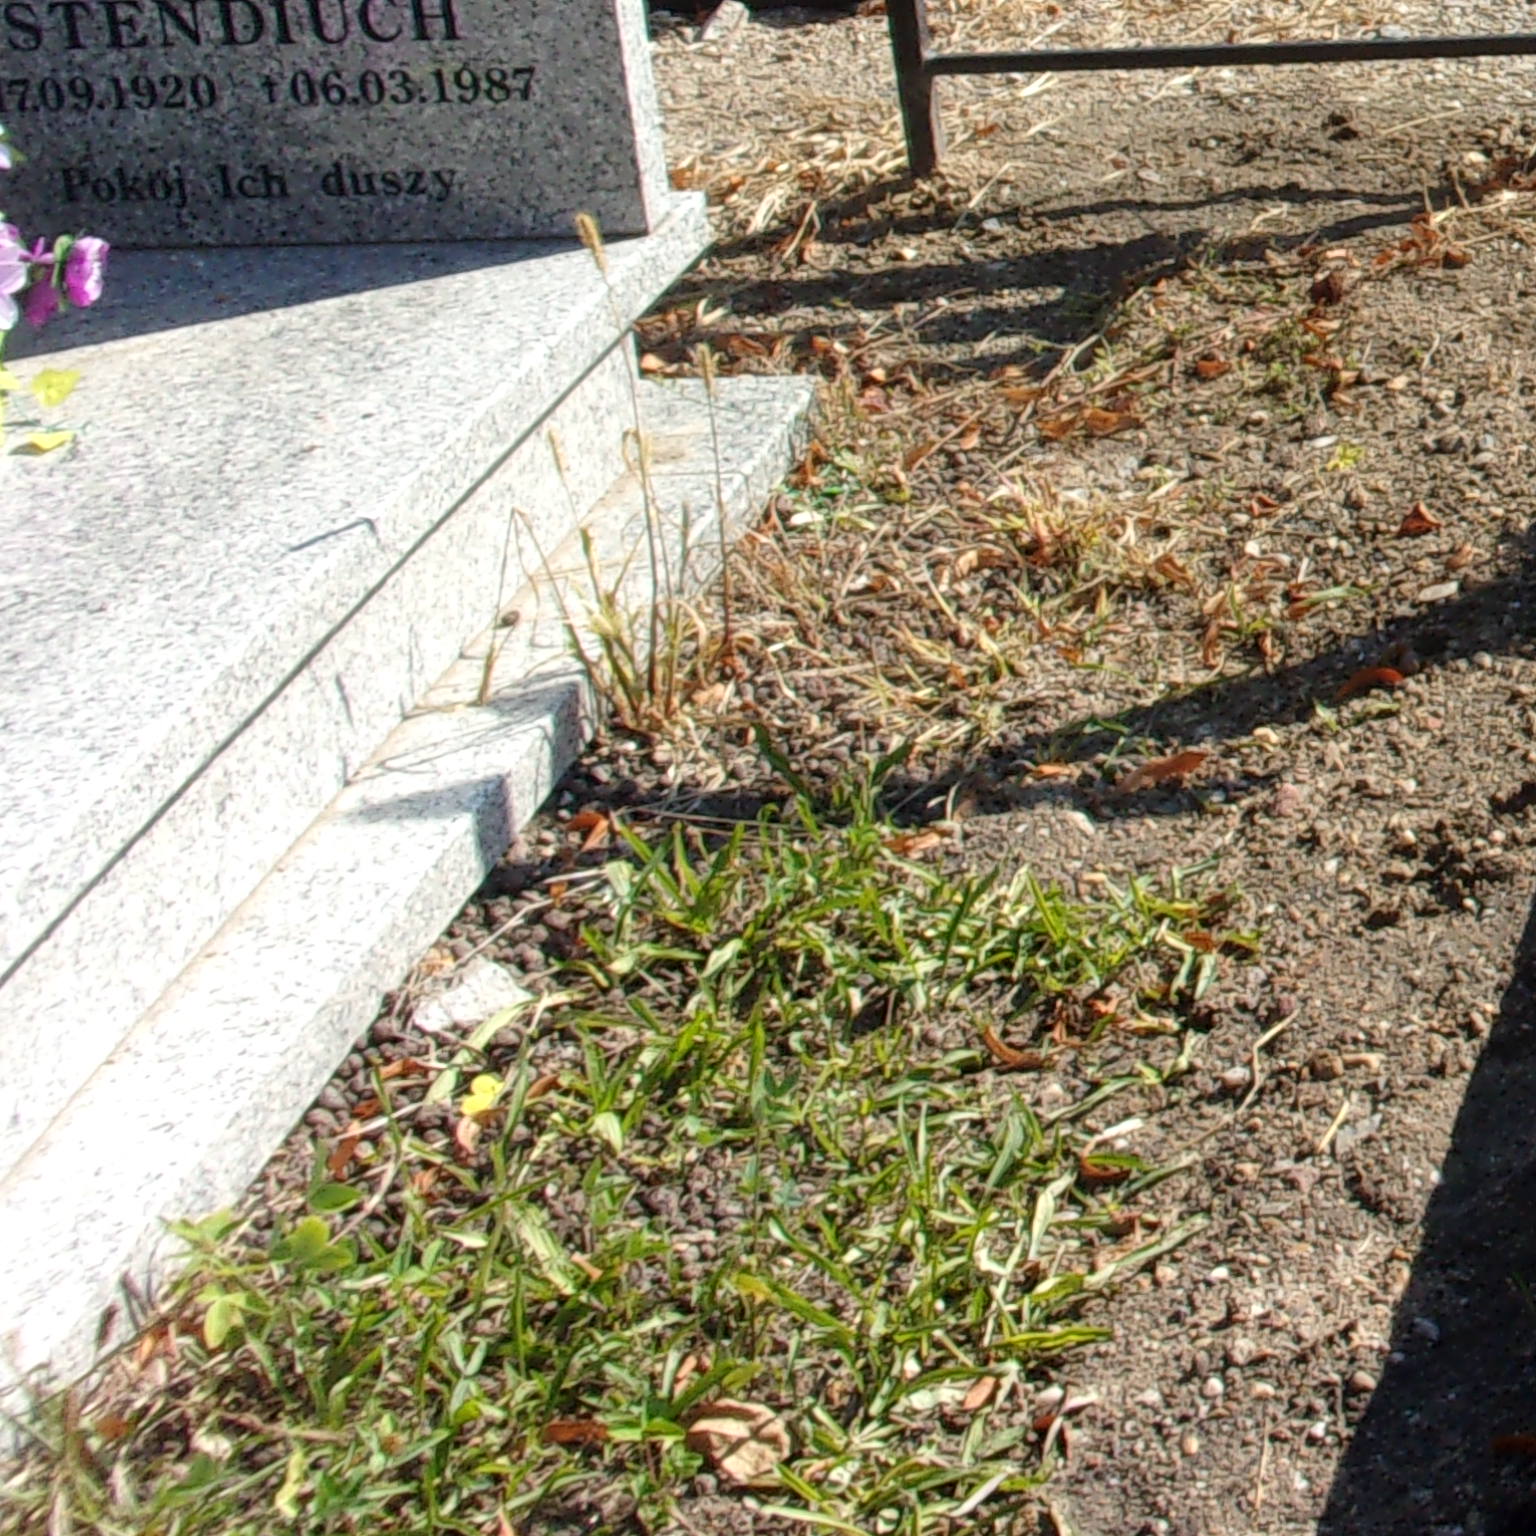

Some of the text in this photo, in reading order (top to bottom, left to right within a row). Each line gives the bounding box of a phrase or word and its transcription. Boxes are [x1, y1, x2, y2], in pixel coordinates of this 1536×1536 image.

[60, 161, 458, 208] Pokój Ich duszy
